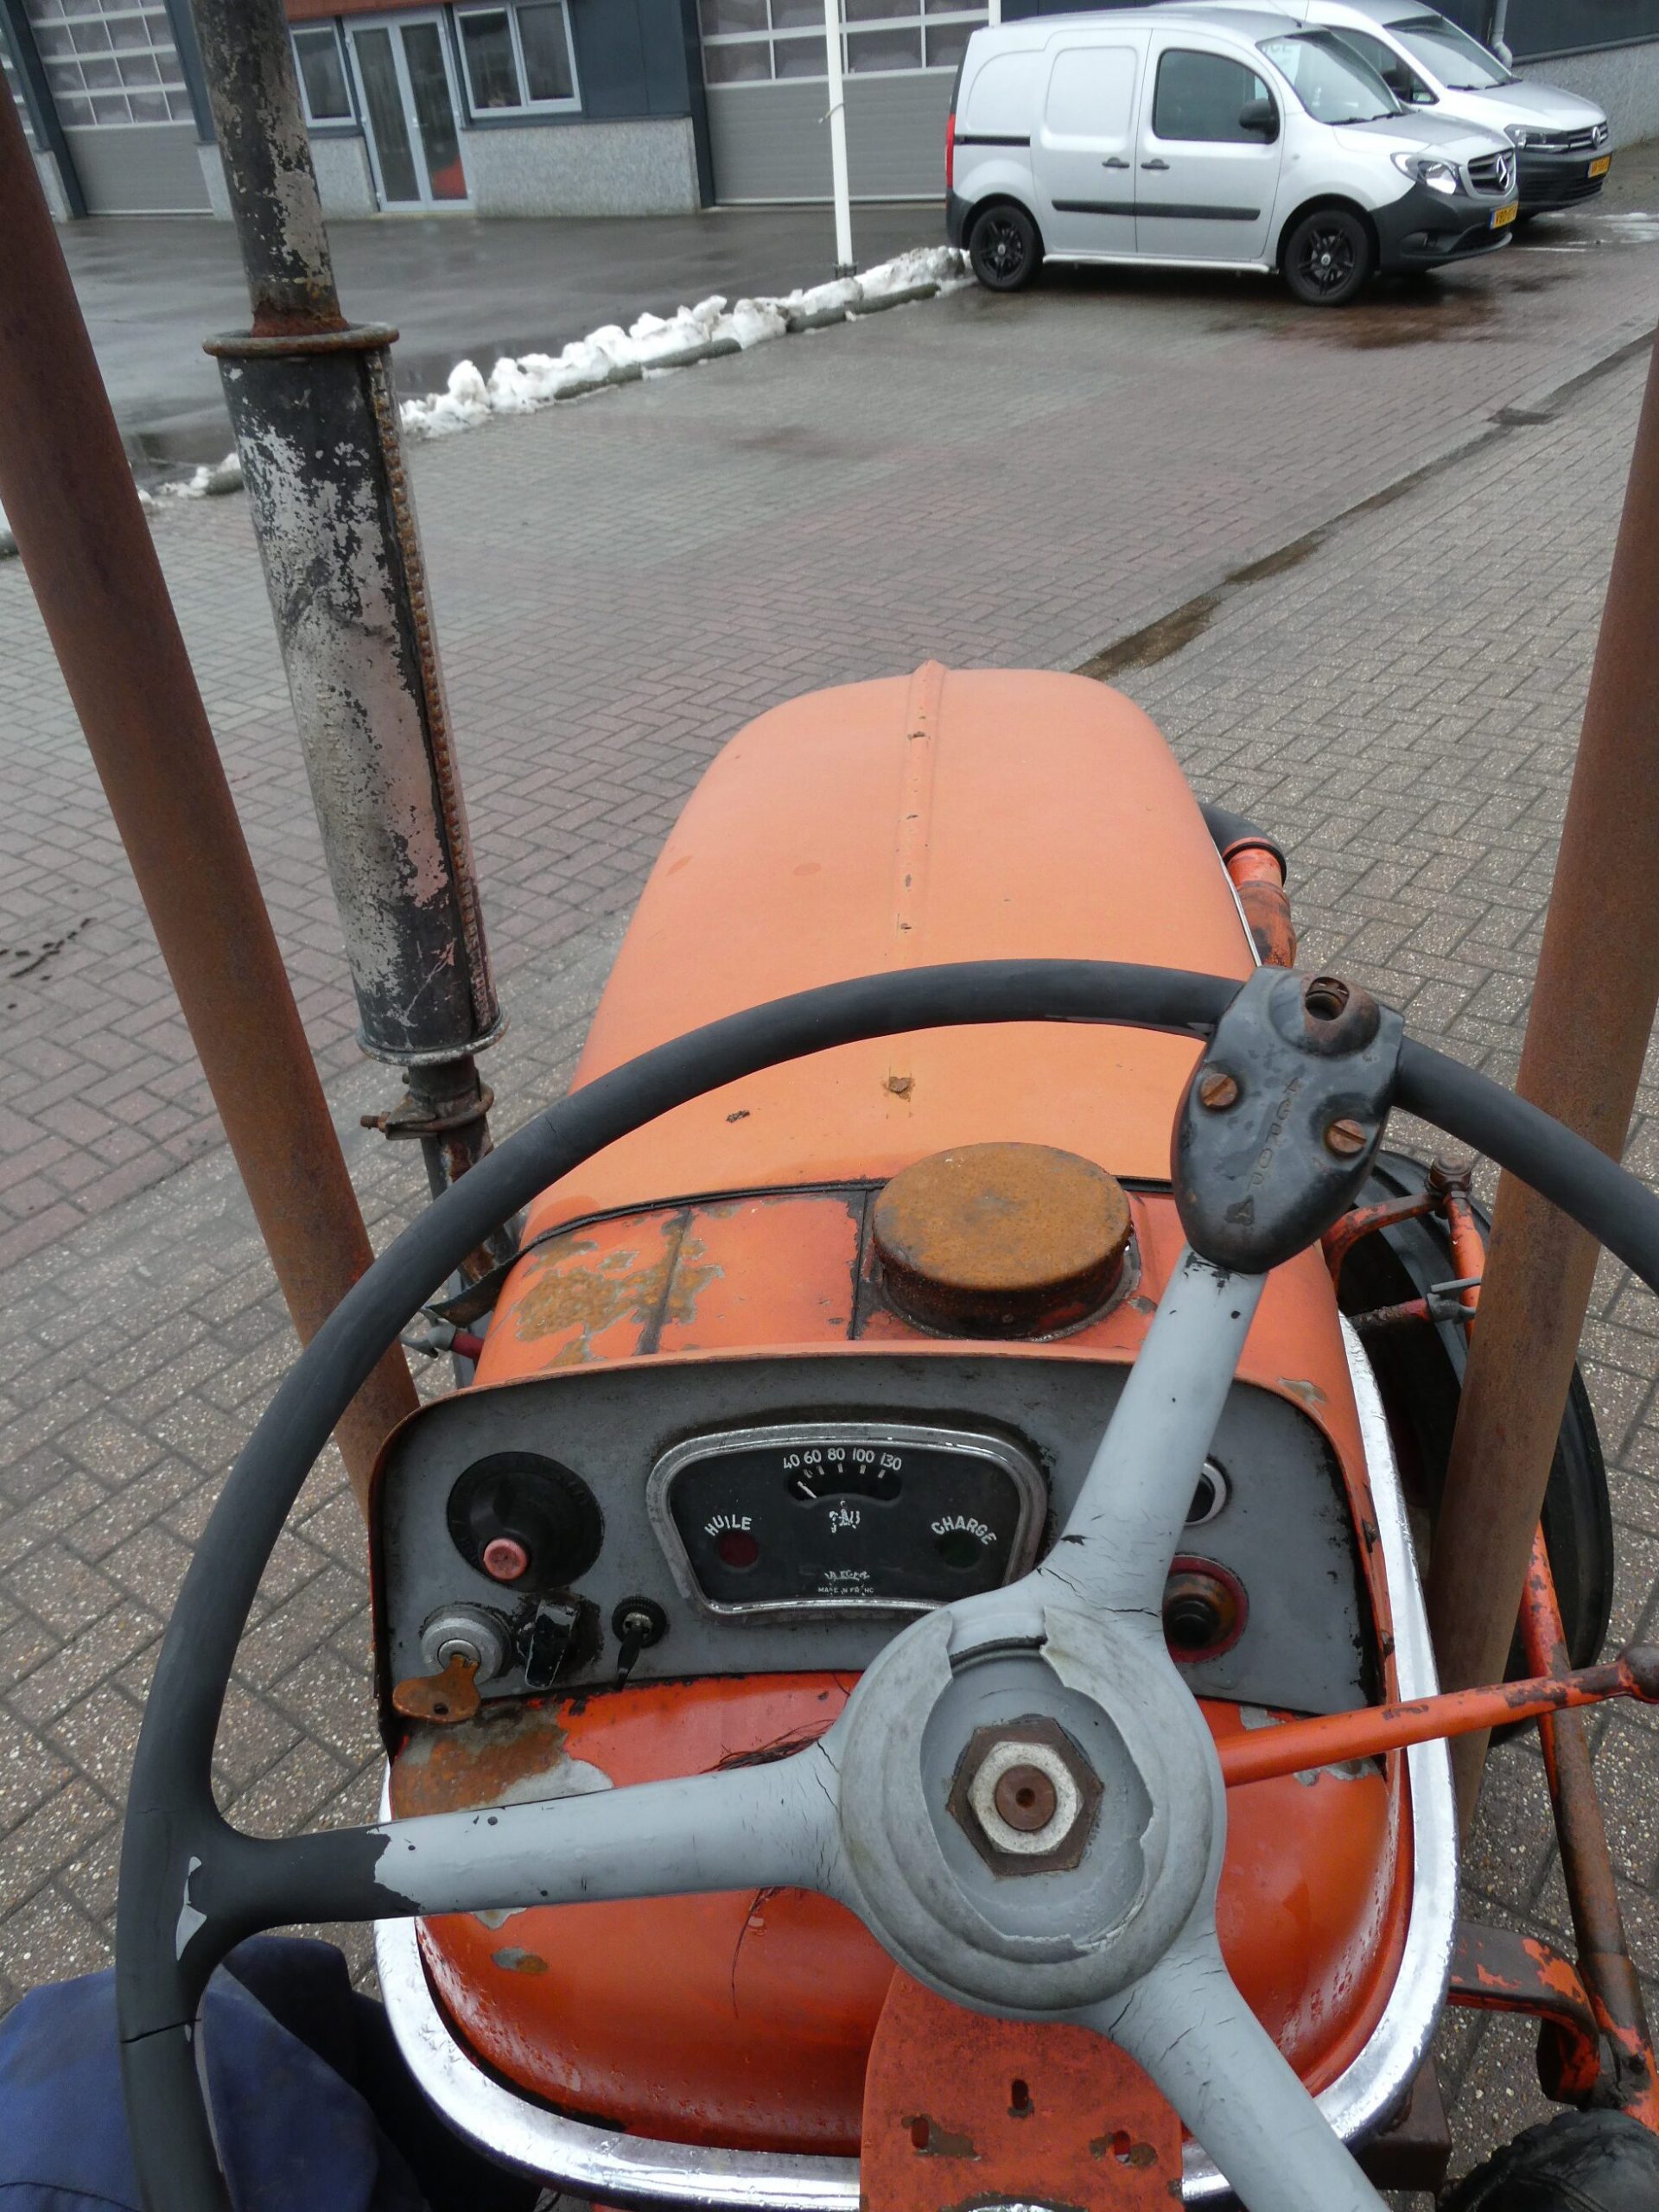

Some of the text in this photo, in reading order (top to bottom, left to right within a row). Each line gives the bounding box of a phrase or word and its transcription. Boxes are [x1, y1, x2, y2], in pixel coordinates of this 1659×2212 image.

[783, 1447, 902, 1471] 40 60 80 100 130
[703, 1514, 752, 1536] HUILE
[931, 1516, 997, 1545] CHARGE
